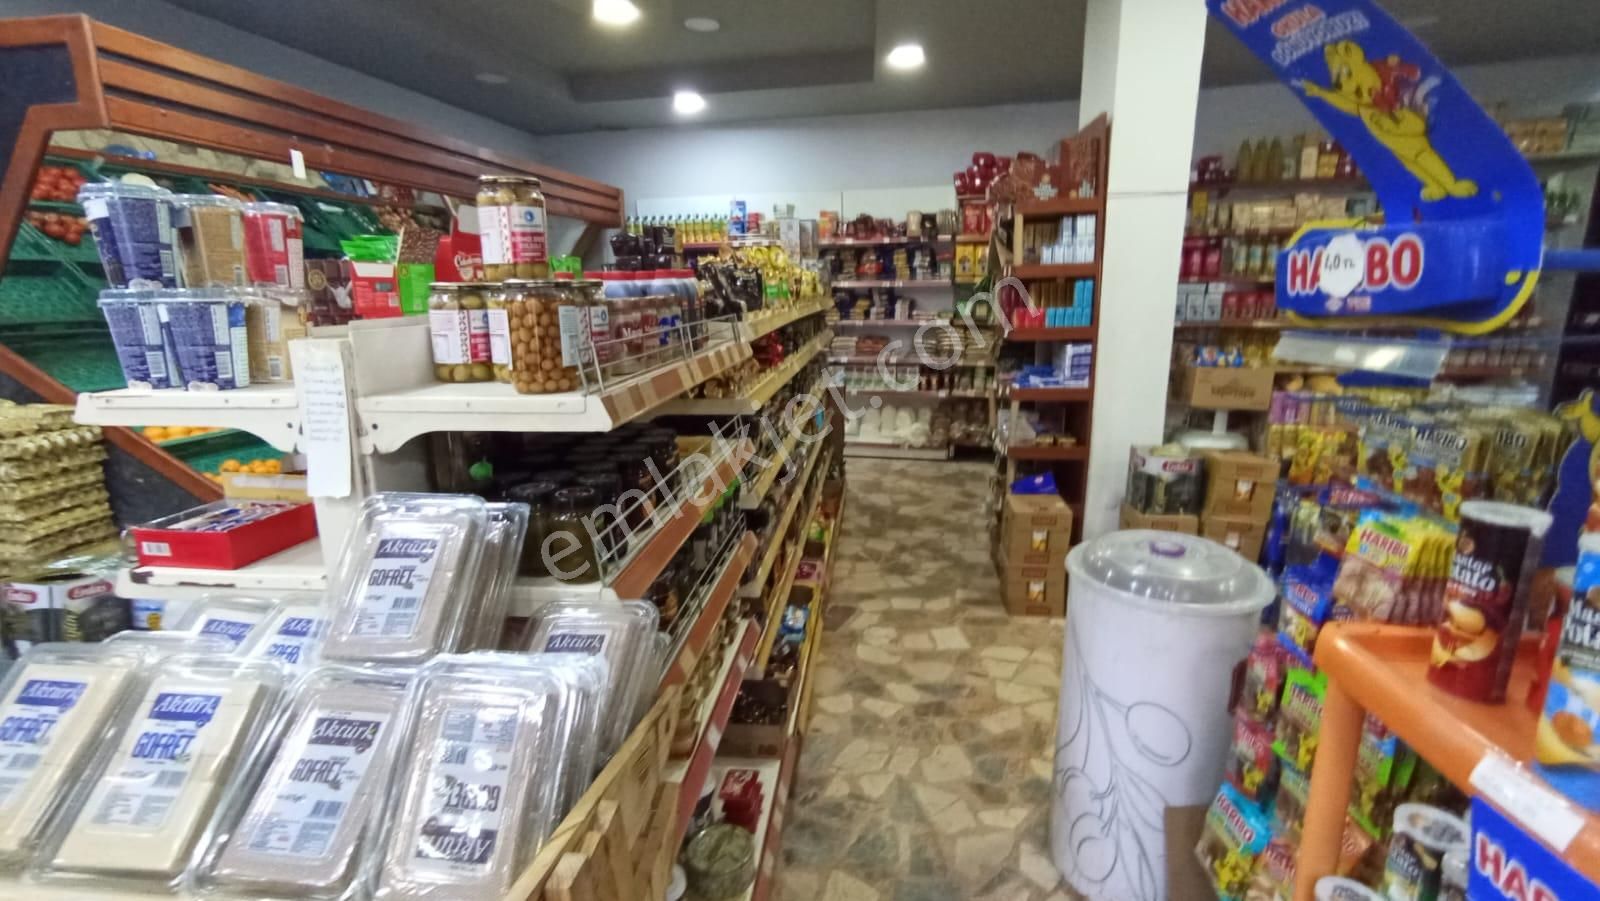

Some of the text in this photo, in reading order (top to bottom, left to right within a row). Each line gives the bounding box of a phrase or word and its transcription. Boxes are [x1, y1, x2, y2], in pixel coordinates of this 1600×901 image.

[1360, 528, 1408, 558] HARIBO
[368, 568, 415, 586] GOFRET
[131, 731, 196, 760] GOFRET
[288, 758, 347, 784] GOFRET
[1217, 793, 1255, 843] HARIBO
